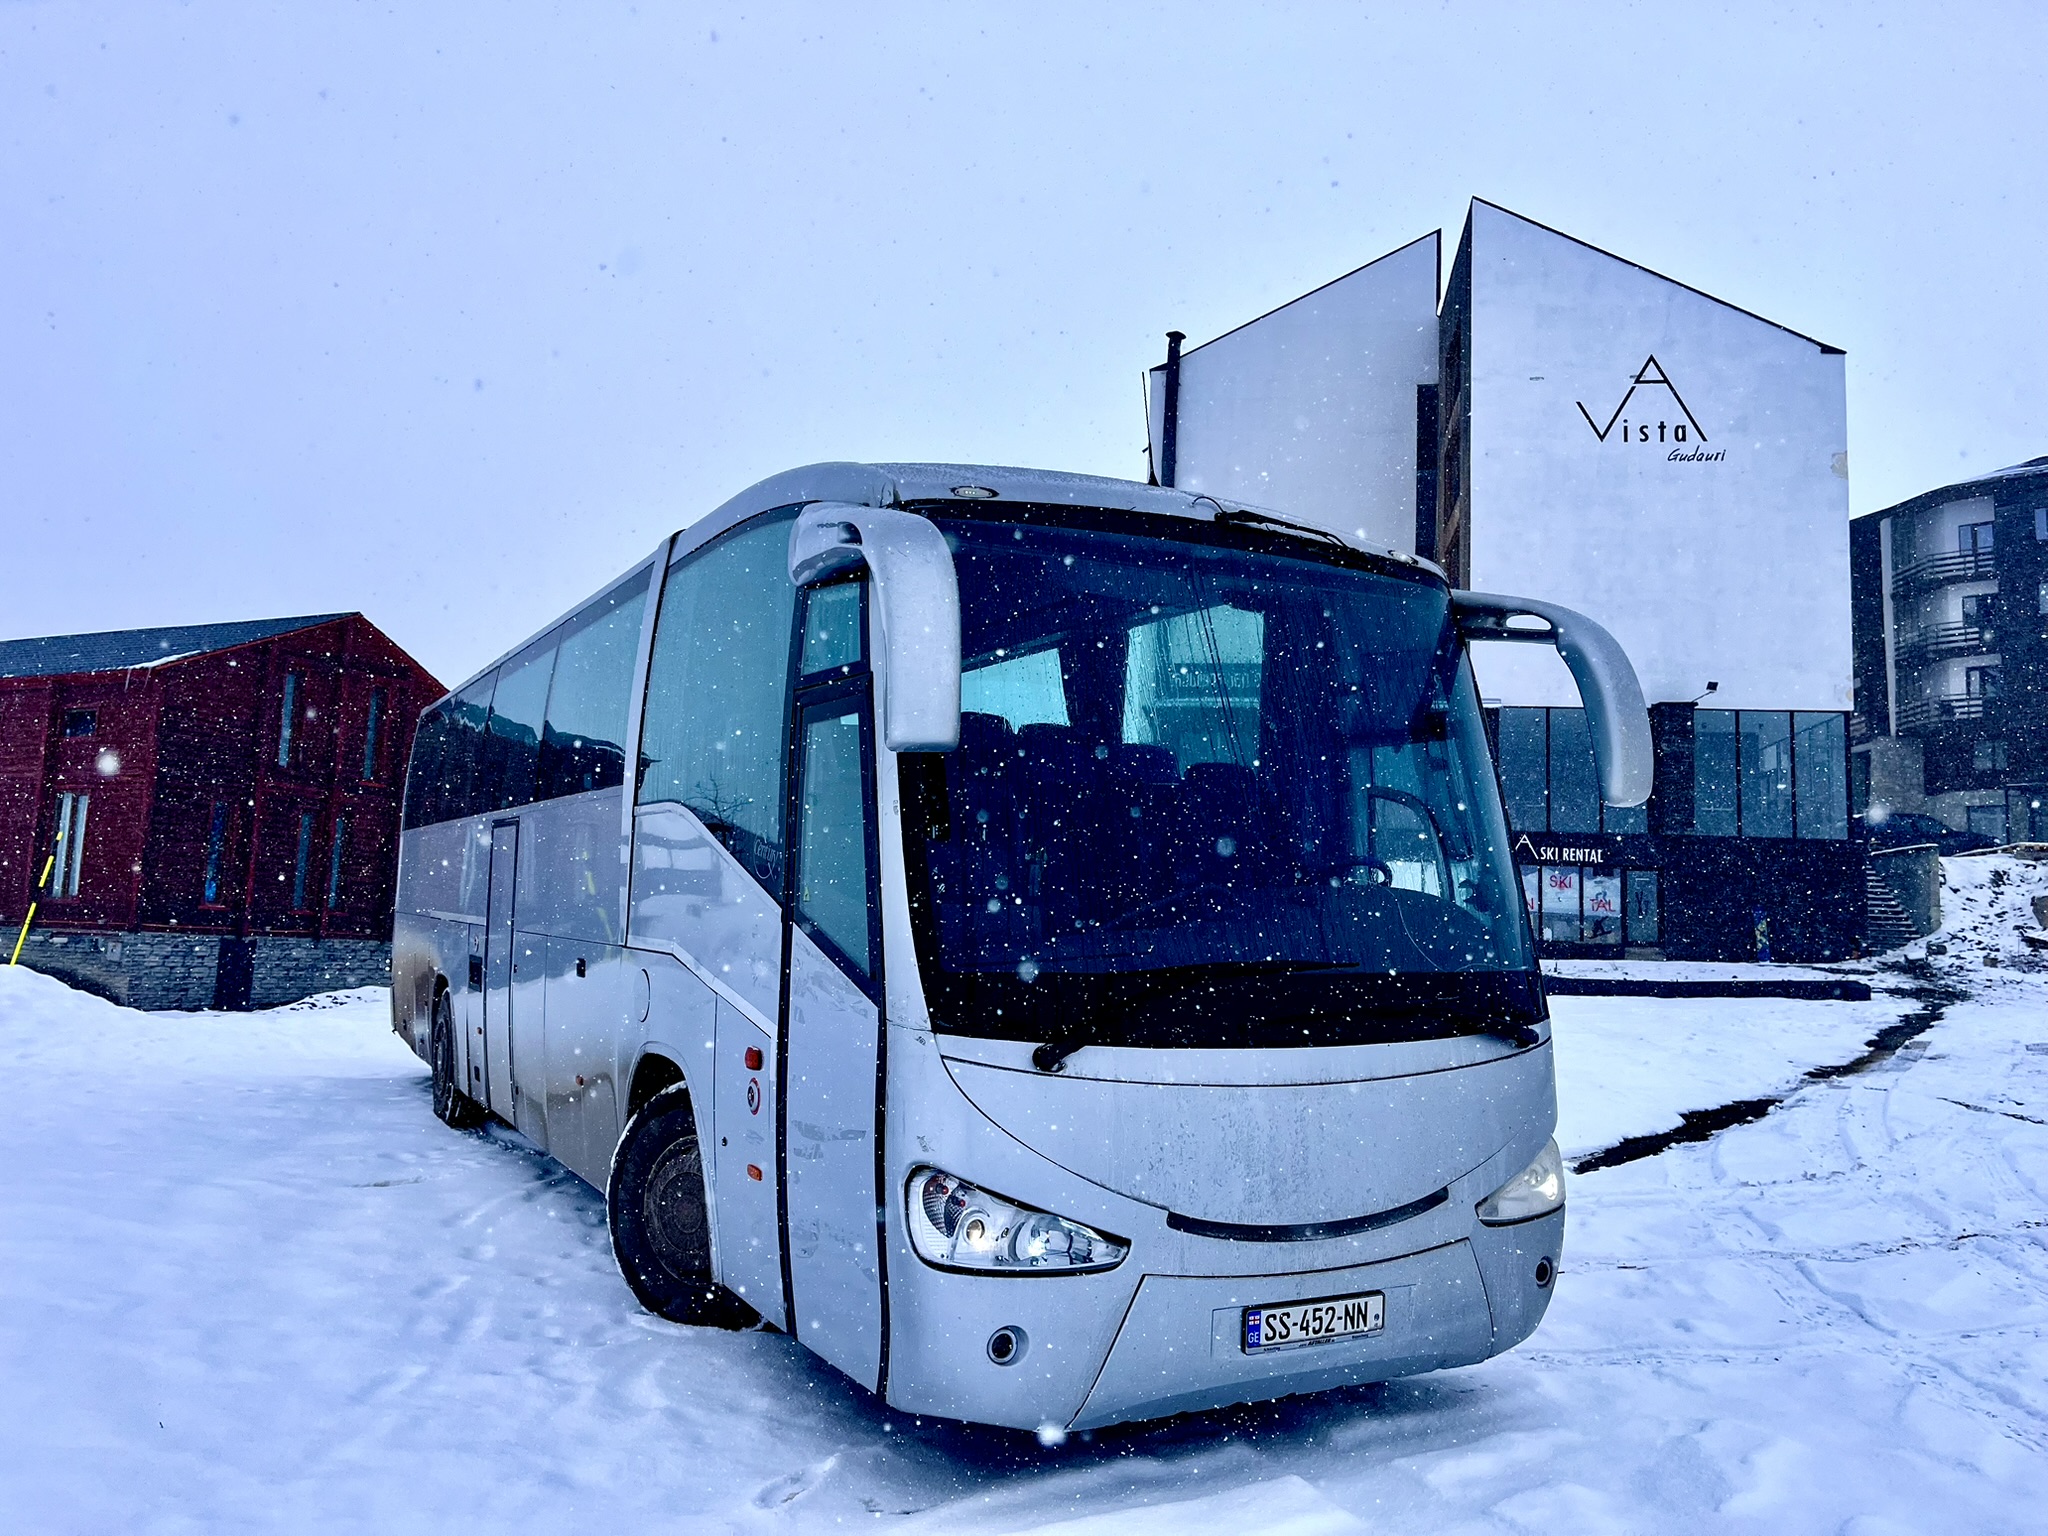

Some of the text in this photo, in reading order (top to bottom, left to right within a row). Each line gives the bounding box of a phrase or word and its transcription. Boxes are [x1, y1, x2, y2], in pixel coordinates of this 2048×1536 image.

[1575, 386, 1687, 443] Vista
[1540, 846, 1559, 860] SKI
[1562, 847, 1604, 863] RENTAL
[1549, 874, 1573, 889] SKI
[1248, 1301, 1368, 1344] GE SS-452-NN
